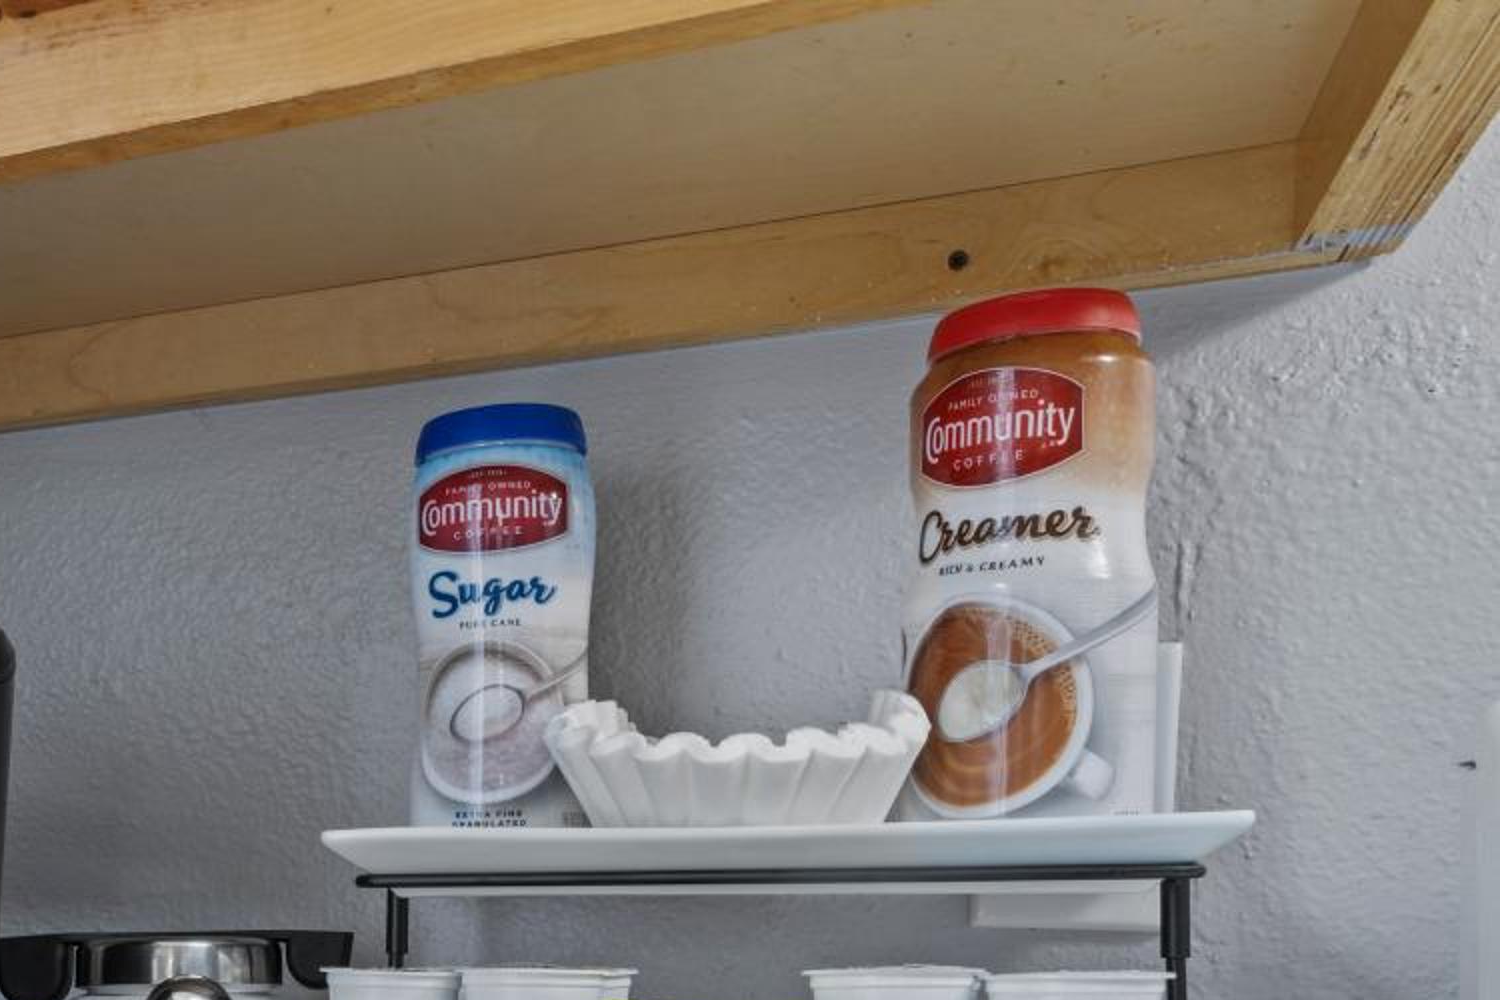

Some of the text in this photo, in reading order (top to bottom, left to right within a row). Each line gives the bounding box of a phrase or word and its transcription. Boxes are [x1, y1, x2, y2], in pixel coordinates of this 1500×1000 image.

[925, 399, 1077, 465] Community
[422, 489, 563, 536] Community
[919, 506, 1101, 564] Creamer
[979, 555, 1045, 572] CREAMY
[429, 570, 558, 618] Sugar
